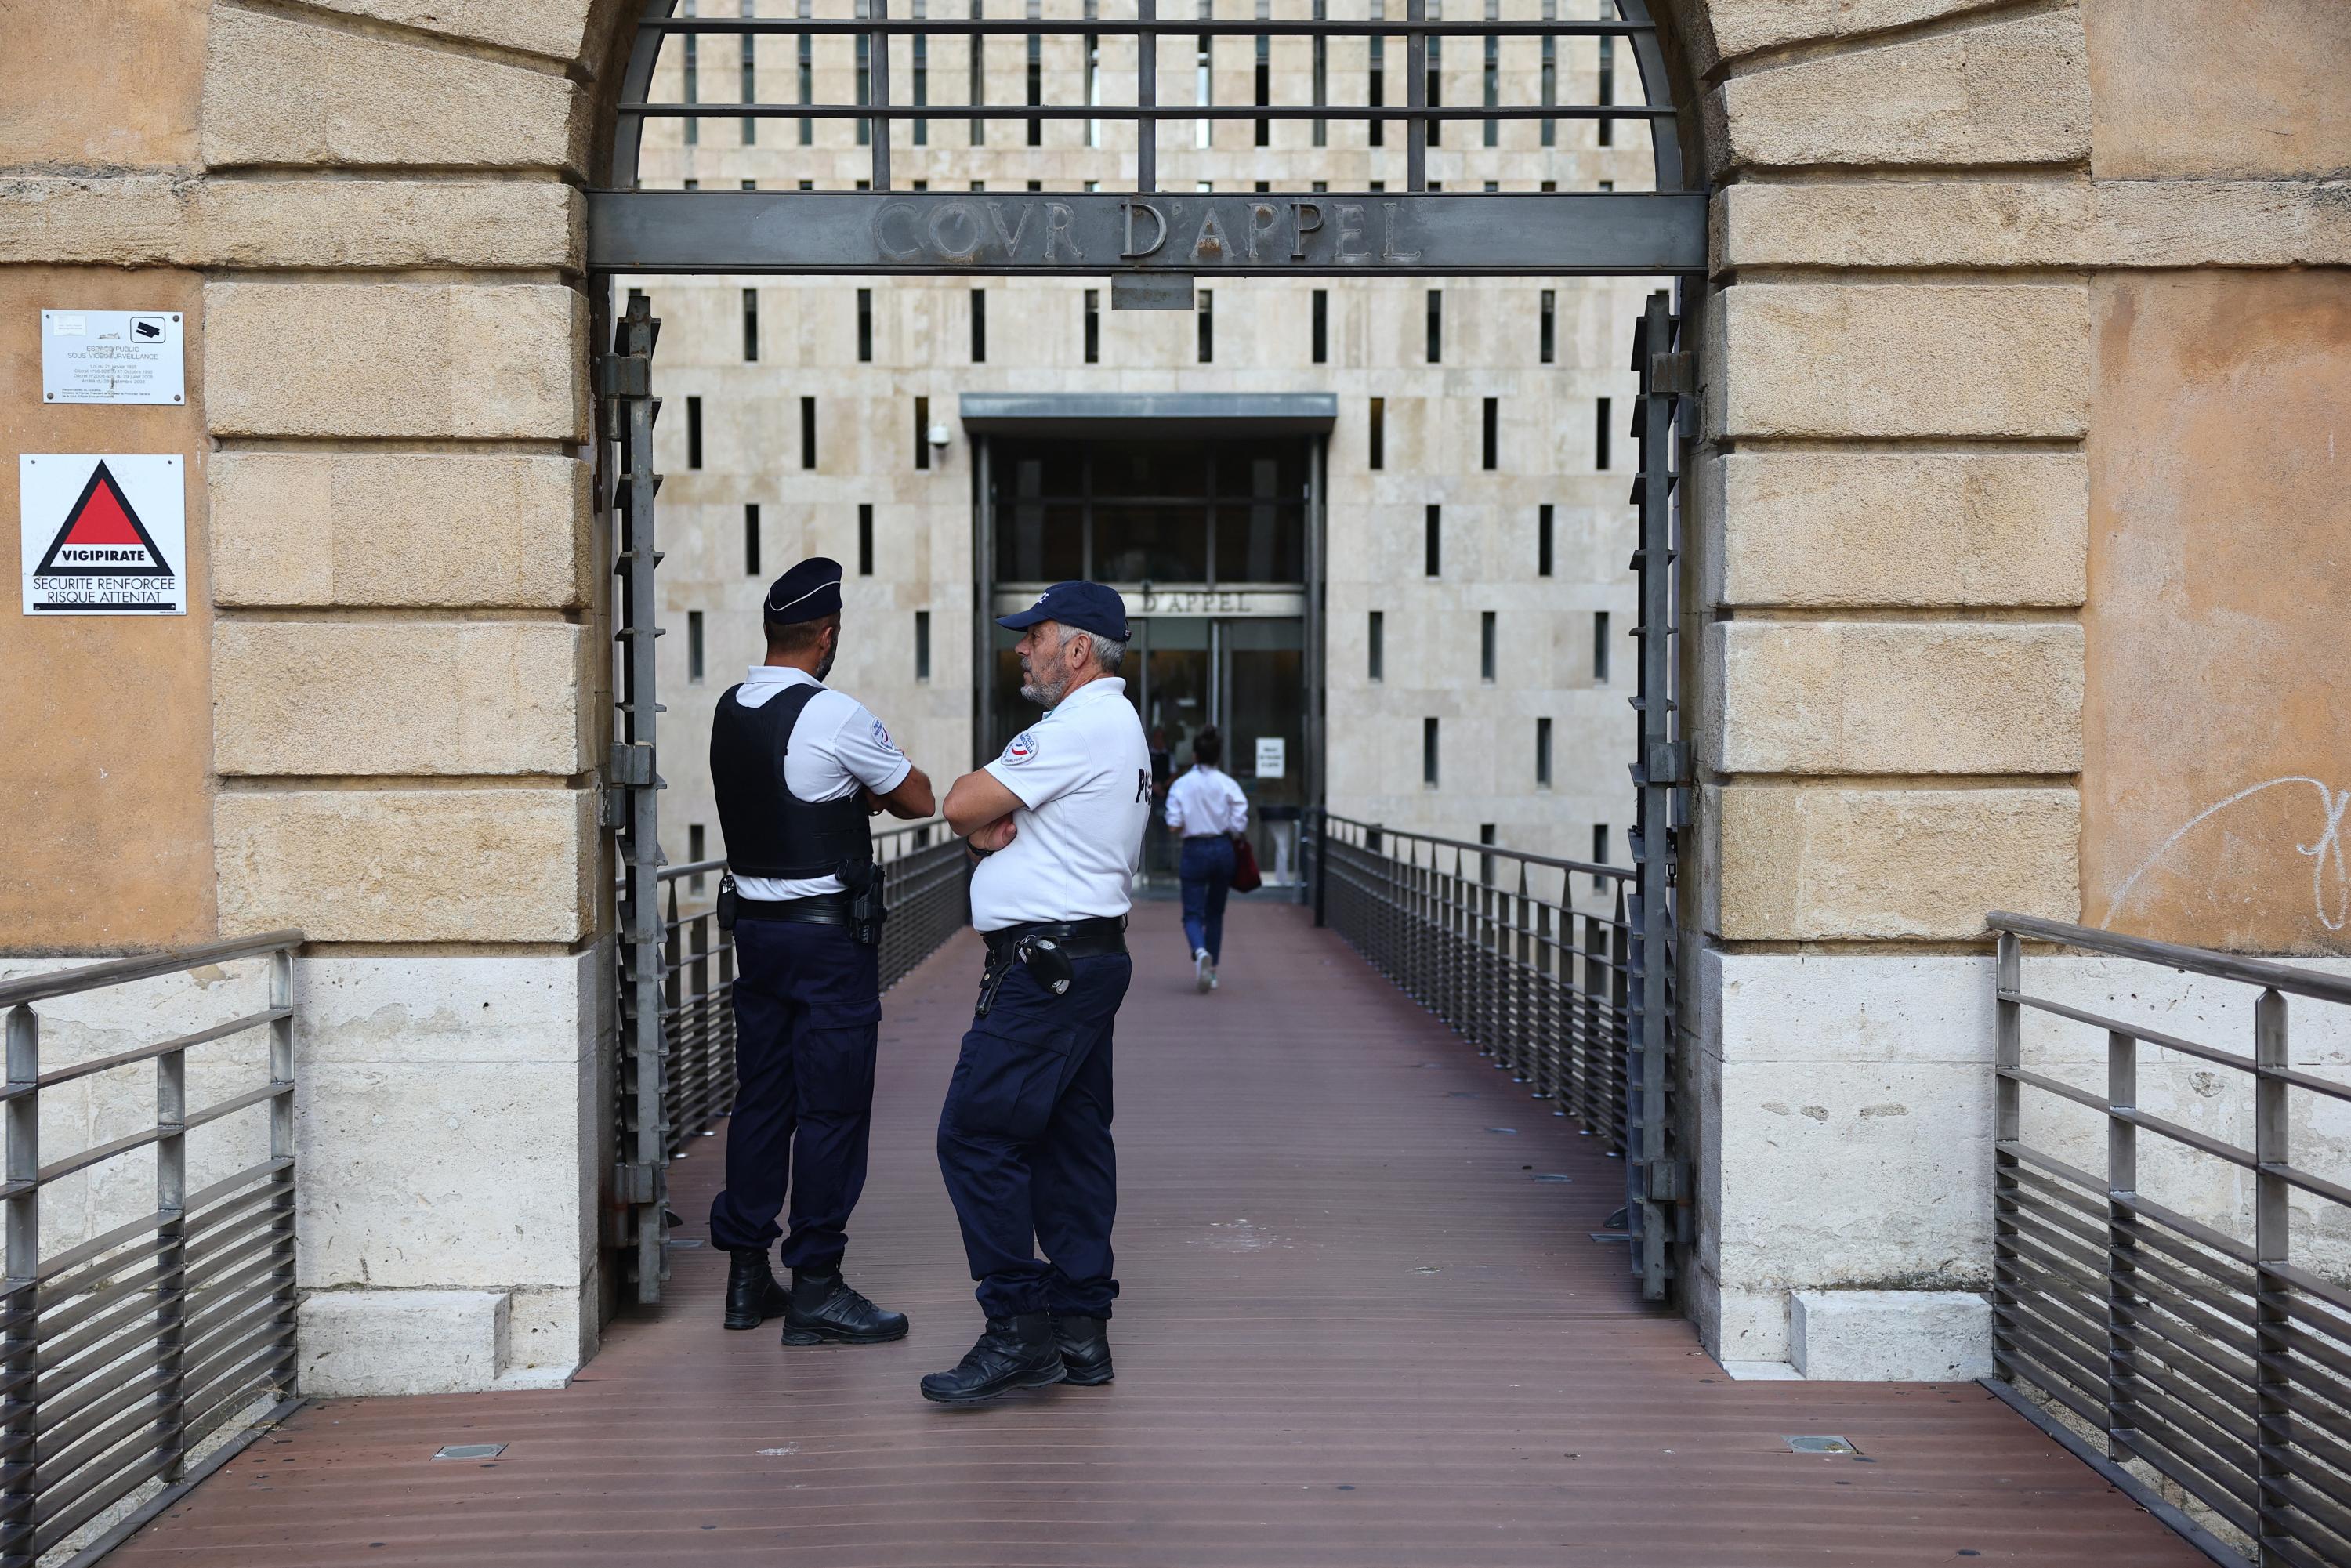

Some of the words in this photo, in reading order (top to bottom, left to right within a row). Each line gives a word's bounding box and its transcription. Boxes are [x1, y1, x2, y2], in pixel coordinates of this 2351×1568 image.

[1121, 202, 1422, 260] D'APPEL
[62, 550, 145, 562] VIGIPIRATE
[33, 578, 92, 590] SECURITE
[98, 578, 176, 590] RENFORCEE
[48, 591, 96, 603] RISQUE
[100, 591, 162, 603] ATTENTAT
